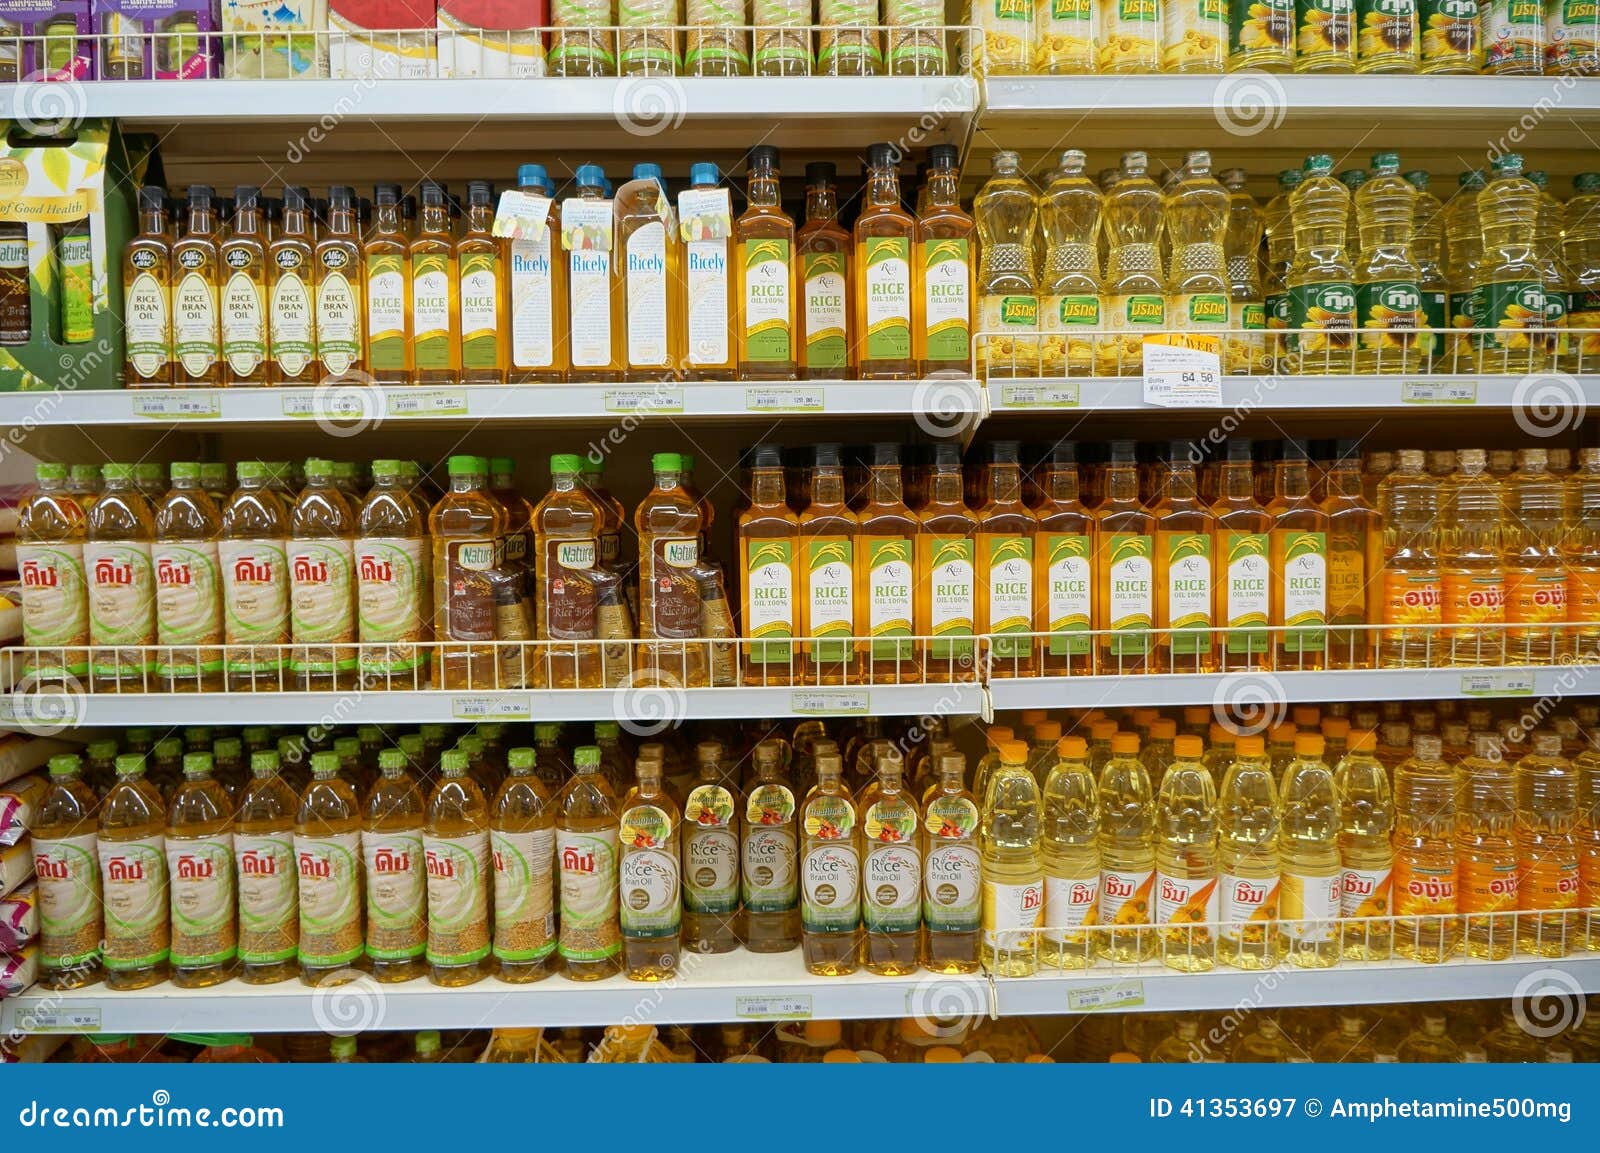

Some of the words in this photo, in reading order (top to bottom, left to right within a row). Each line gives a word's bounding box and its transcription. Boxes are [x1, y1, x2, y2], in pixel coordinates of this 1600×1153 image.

[15, 202, 43, 214] Good
[47, 201, 82, 214] Health
[514, 254, 549, 276] Ricely
[573, 254, 608, 276] Ricely
[630, 253, 663, 274] Ricely
[690, 252, 724, 274] Ricely
[752, 285, 784, 296] RICE
[872, 283, 904, 294] RICE
[931, 285, 963, 295] RICE
[326, 294, 345, 302] RICE
[373, 298, 400, 307] RICE
[418, 298, 445, 307] RICE
[465, 297, 492, 307] RICE
[810, 296, 841, 306] RICE
[182, 303, 207, 311] BRAN
[234, 311, 249, 319] OIL
[329, 311, 343, 319] OIL
[1182, 372, 1213, 382] 64.50
[995, 583, 1027, 594] RICE
[1054, 581, 1085, 591] RICE
[1115, 580, 1147, 592] RICE
[1174, 580, 1206, 591] RICE
[1233, 579, 1265, 590] RICE
[1290, 577, 1321, 589] RICE
[754, 587, 787, 599] RICE
[815, 587, 848, 598] RICE
[875, 586, 908, 597] RICE
[937, 585, 969, 596] RICE
[691, 842, 719, 856] Rice
[749, 842, 776, 855] Rice
[708, 856, 719, 864] Oil
[810, 857, 838, 872] Rice
[872, 856, 900, 872] Rice
[932, 857, 961, 871] Rice
[625, 862, 652, 876] Rice
[641, 878, 652, 886] Oil
[827, 873, 839, 881] Oil
[888, 873, 900, 881] Oil
[950, 872, 961, 881] Oil
[1107, 876, 1133, 897] ชิม
[1344, 874, 1372, 894] ชิม
[1162, 881, 1186, 902] ชิม
[1236, 882, 1264, 902] ชิม
